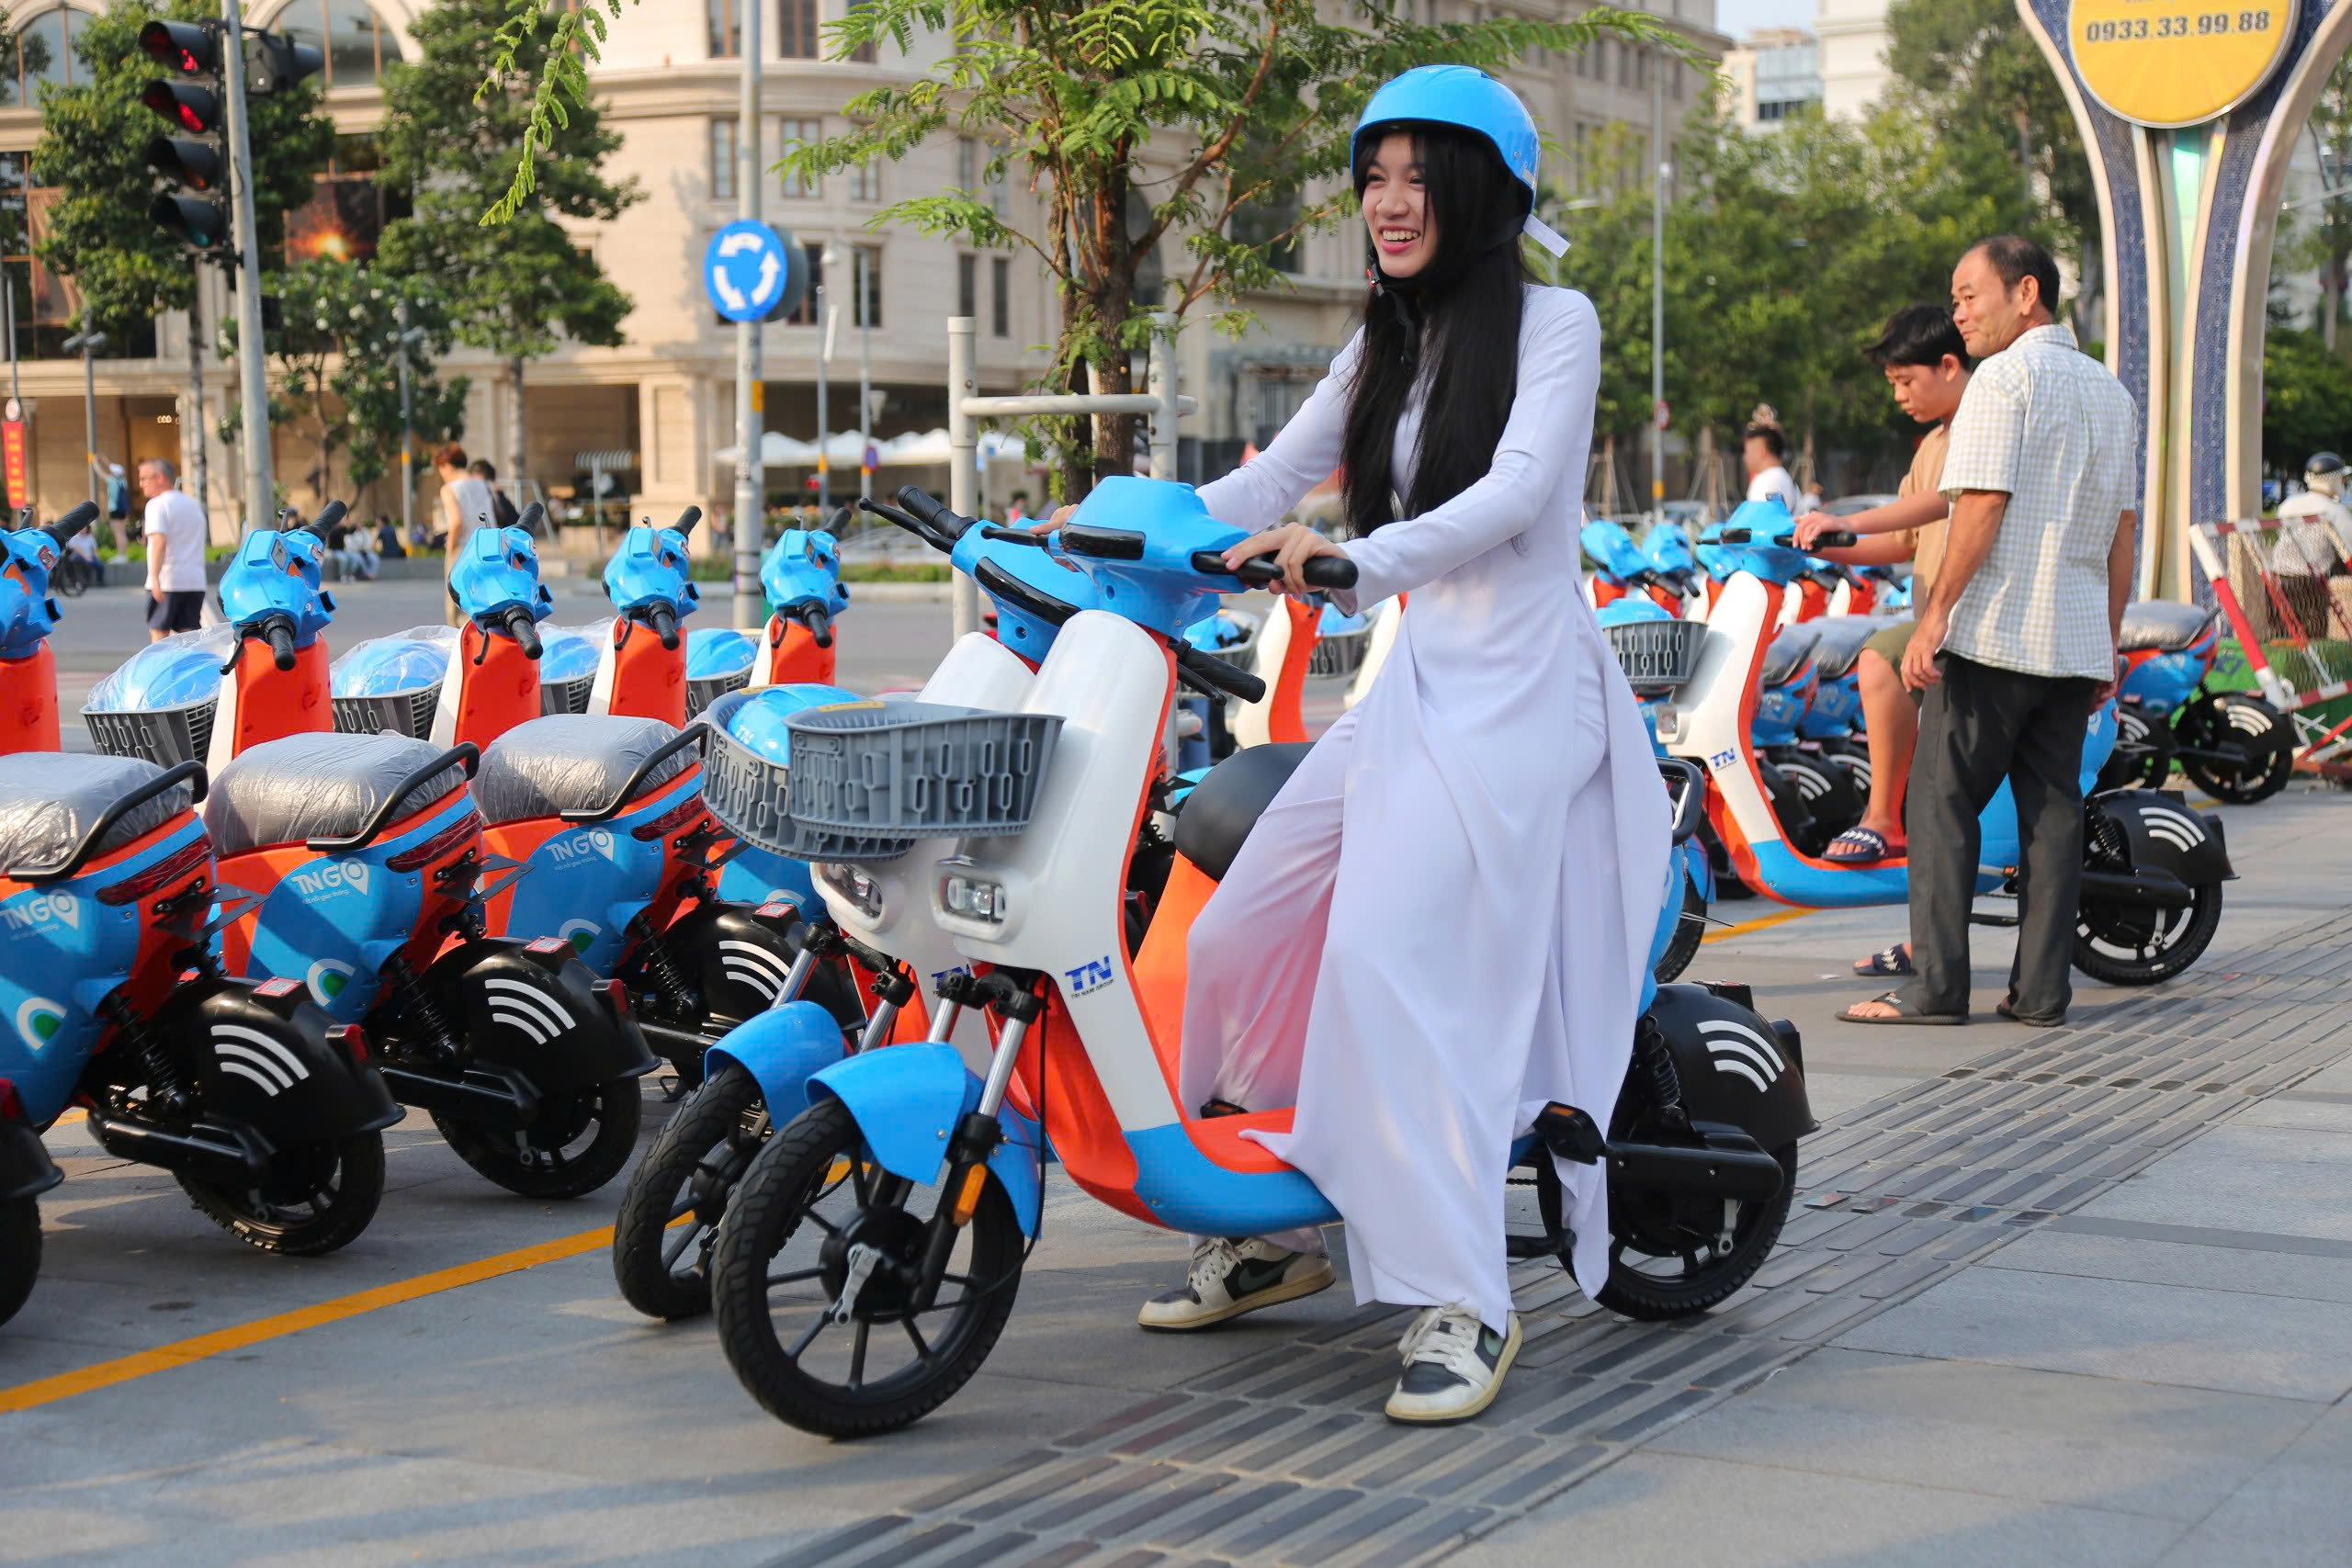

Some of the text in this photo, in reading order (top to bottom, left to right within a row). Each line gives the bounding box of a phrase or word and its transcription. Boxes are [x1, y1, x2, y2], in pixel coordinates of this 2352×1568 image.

[2086, 11, 2269, 42] 0933.33.99.88
[1711, 748, 1736, 768] TN
[1065, 955, 1112, 991] TN
